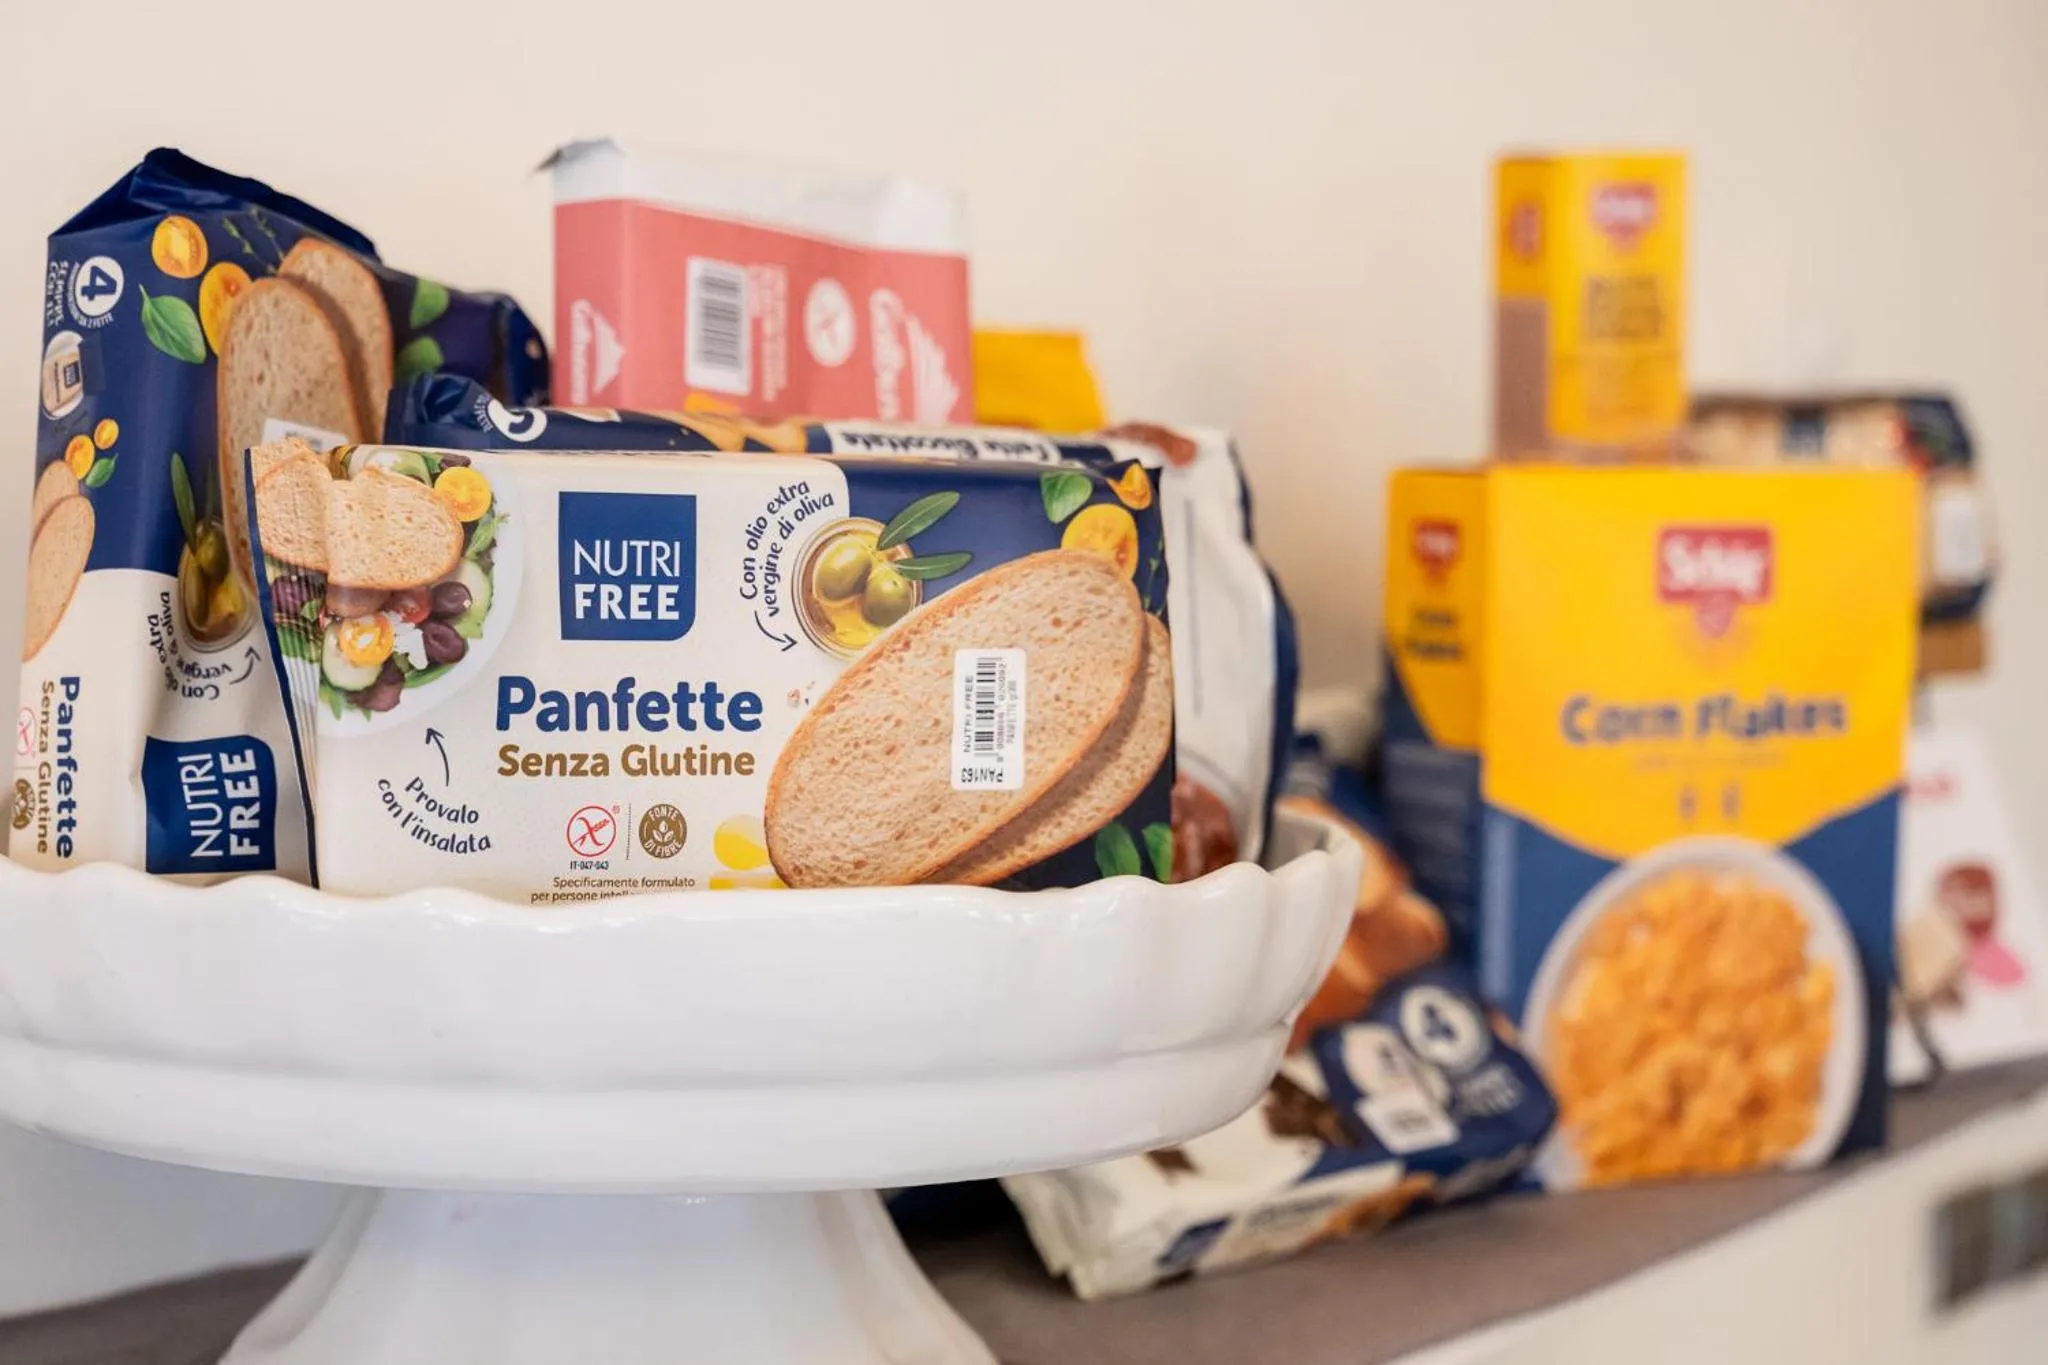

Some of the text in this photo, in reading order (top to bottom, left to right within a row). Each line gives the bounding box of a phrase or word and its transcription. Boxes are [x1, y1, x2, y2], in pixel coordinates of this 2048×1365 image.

[81, 265, 117, 301] 4
[573, 539, 681, 577] NUTRI
[740, 481, 810, 600] Con olio extra
[759, 493, 834, 618] vergine di oliva
[160, 591, 175, 637] oliva
[574, 583, 680, 620] FREE
[147, 614, 167, 664] extra
[182, 684, 220, 700] Con
[496, 675, 763, 732] Panfette
[1560, 687, 1847, 744] Corn Flakes
[37, 681, 54, 853] Senza Glutine
[57, 677, 80, 858] Panfette
[497, 744, 755, 777] Senza Glutine
[962, 767, 1004, 783] PAN163
[177, 753, 224, 857] NUTRI
[219, 748, 260, 856] FREE
[378, 779, 491, 854] con l'insalata
[405, 776, 479, 824] Provalo
[648, 805, 680, 821] FONTE
[655, 839, 683, 857] FIBRE
[531, 892, 550, 904] per
[552, 891, 598, 902] persone
[553, 877, 695, 889] Specificamente formulato
